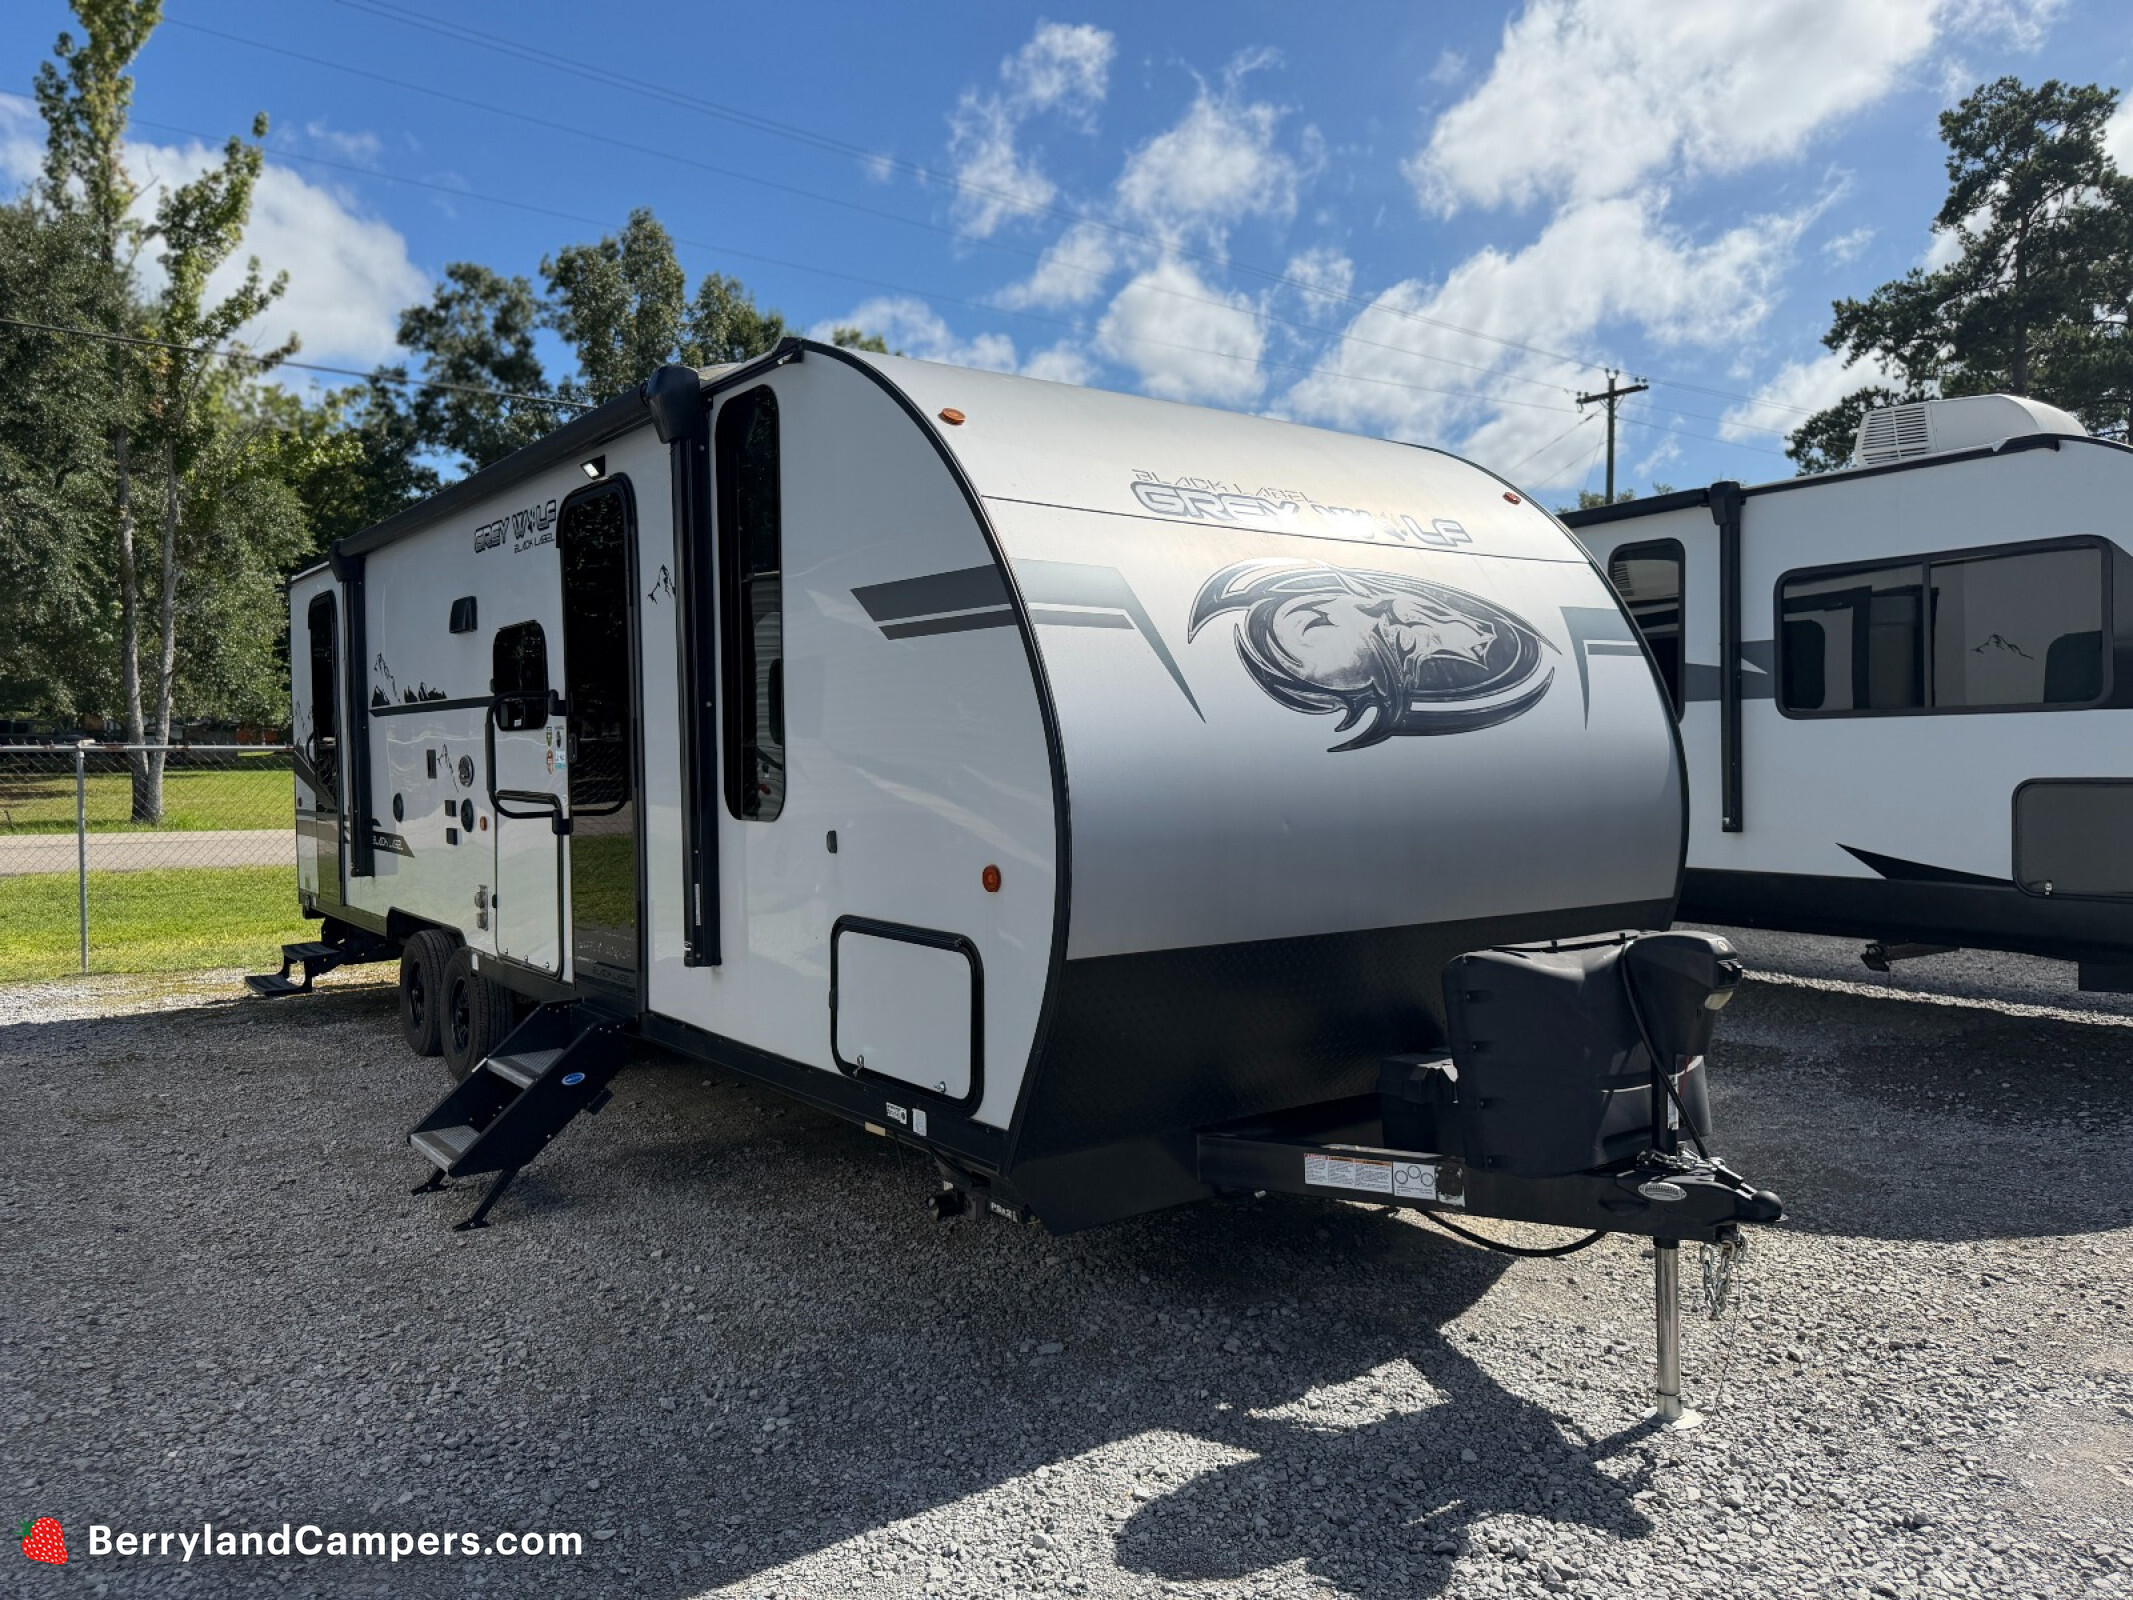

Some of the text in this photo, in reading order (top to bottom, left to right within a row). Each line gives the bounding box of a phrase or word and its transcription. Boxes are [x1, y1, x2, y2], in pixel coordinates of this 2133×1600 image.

[1130, 481, 1300, 522] GREY
[1131, 468, 1315, 503] BLACK LABEL
[475, 516, 510, 554] GREY
